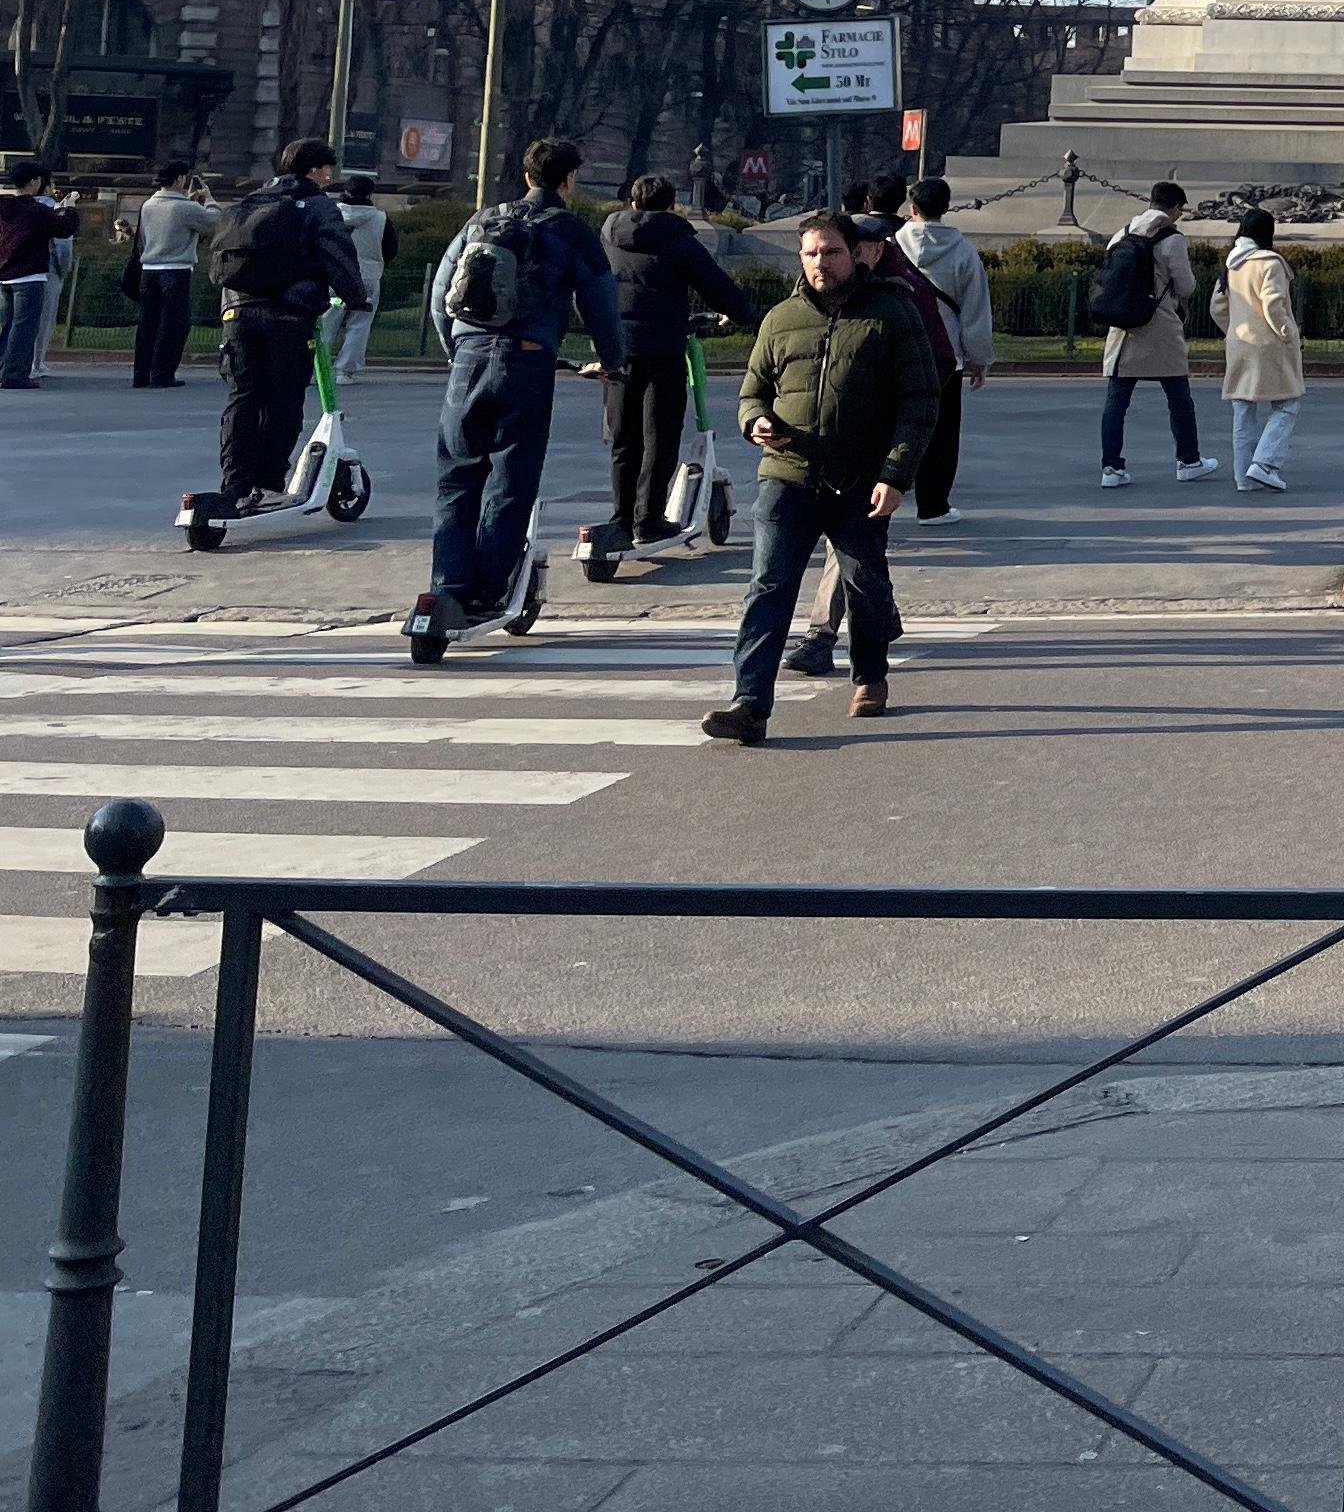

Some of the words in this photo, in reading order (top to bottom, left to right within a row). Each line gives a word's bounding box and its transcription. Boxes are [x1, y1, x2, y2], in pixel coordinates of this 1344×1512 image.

[834, 75, 851, 88] 50
[904, 120, 920, 142] M
[742, 157, 767, 174] M
